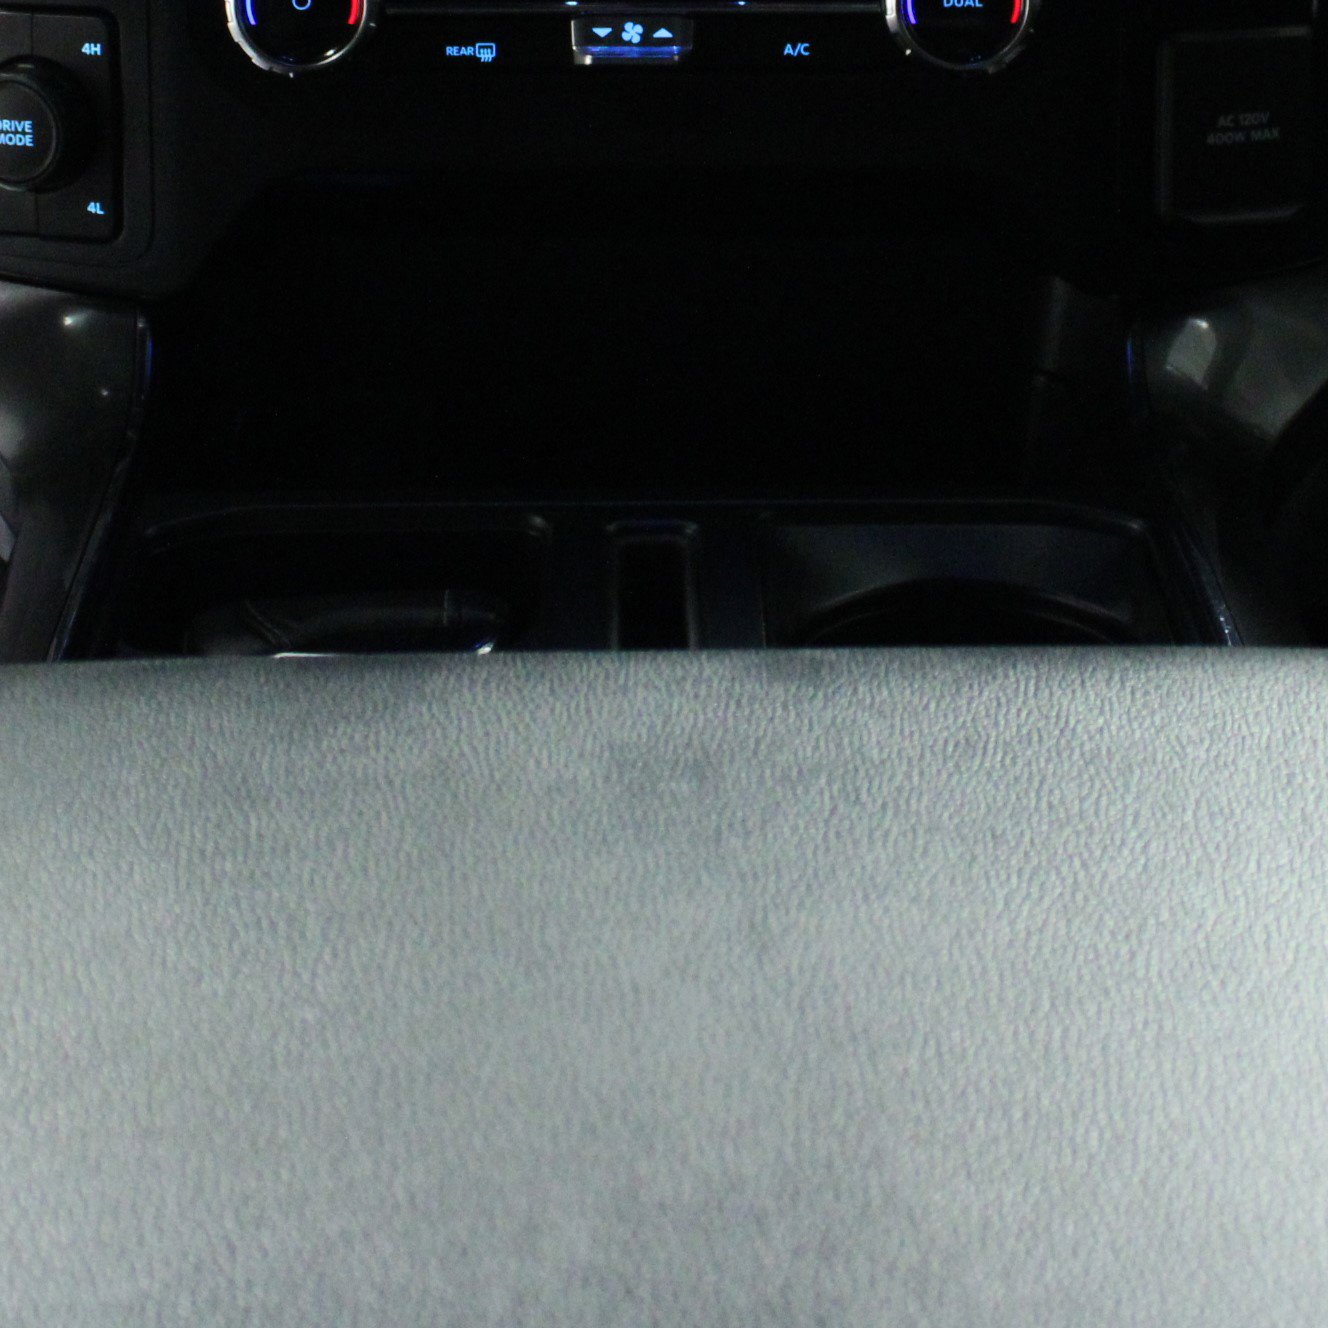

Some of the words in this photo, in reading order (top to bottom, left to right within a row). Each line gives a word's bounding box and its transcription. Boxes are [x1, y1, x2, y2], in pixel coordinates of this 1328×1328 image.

[82, 43, 102, 55] 4H
[446, 46, 475, 56] REAR
[784, 43, 810, 56] A/C
[87, 202, 104, 214] 4L
